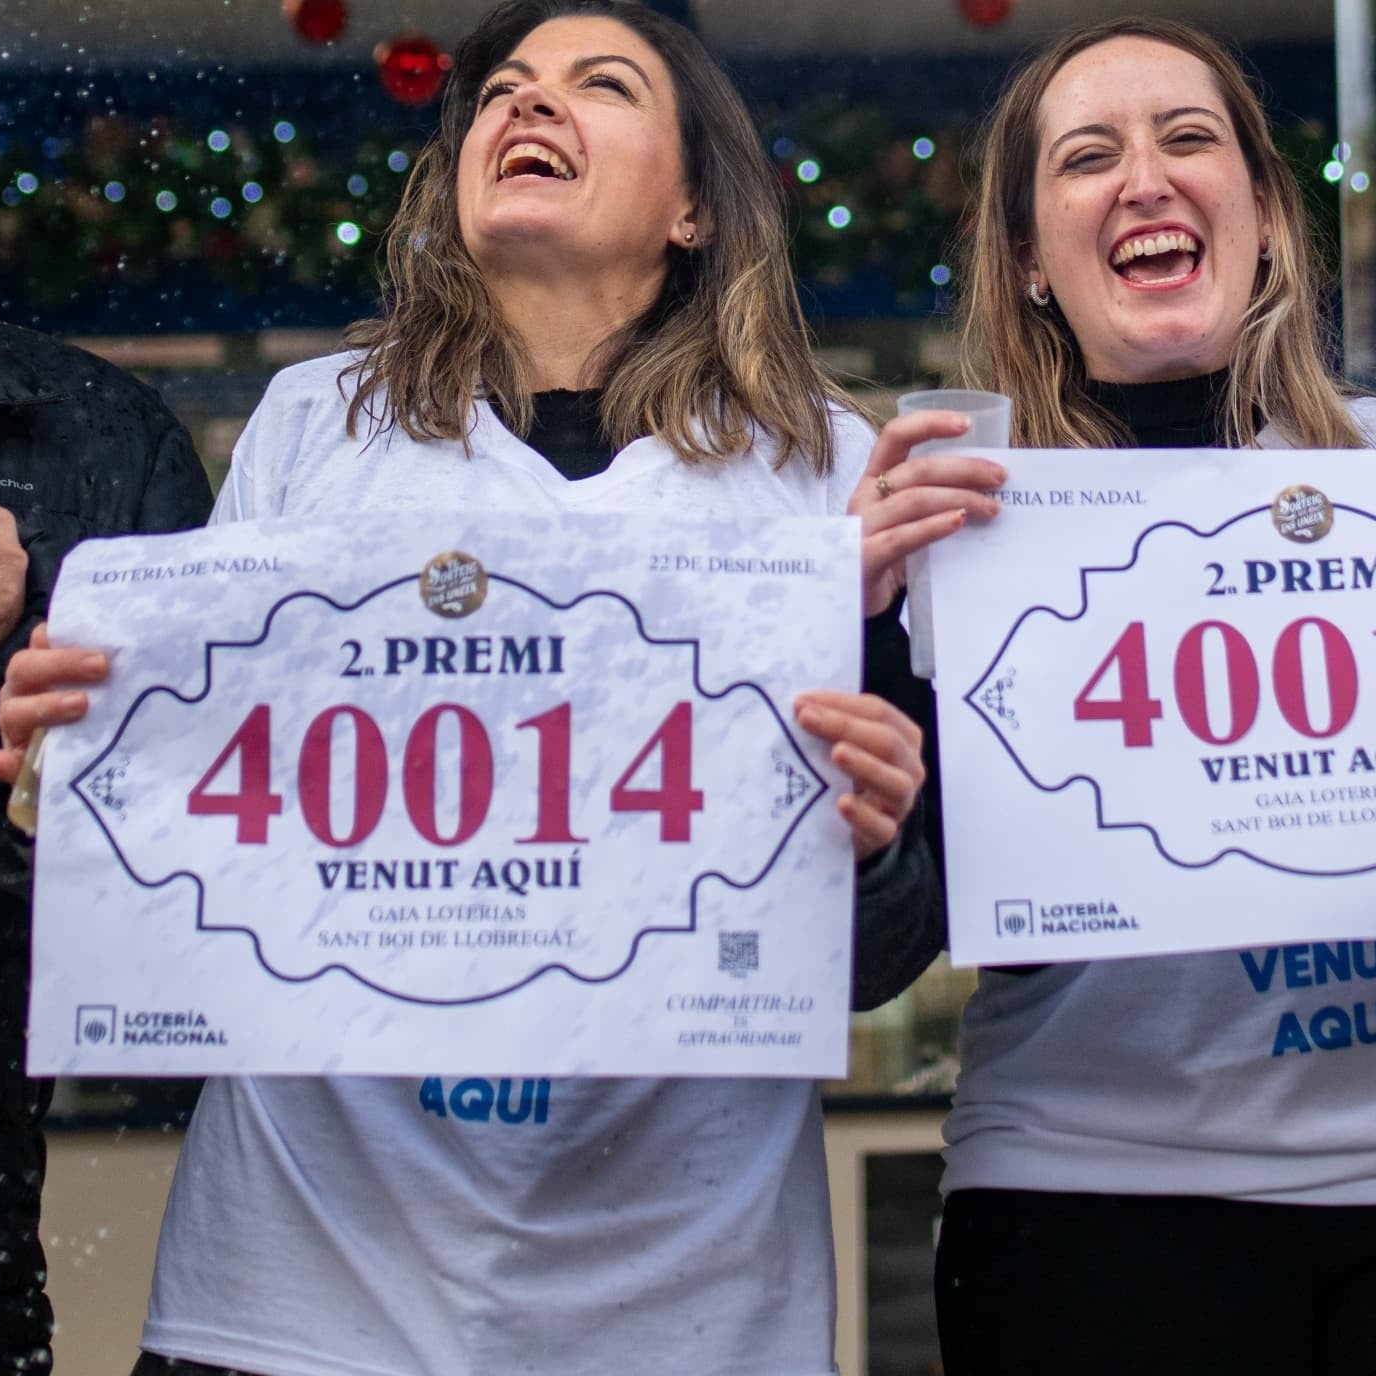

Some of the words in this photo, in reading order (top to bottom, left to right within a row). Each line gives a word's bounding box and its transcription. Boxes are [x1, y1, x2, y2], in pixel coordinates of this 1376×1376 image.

[982, 489, 1044, 506] TERIA
[1049, 489, 1074, 505] DE
[1080, 489, 1147, 505] NADAL
[92, 565, 175, 585] LOTERIA
[181, 561, 208, 576] DE
[212, 556, 284, 575] NADAL
[647, 554, 670, 572] 22
[675, 555, 703, 572] DE
[708, 555, 817, 575] DESEMBRE
[383, 635, 565, 676] PREMI
[186, 700, 705, 849] 40014
[1200, 748, 1336, 784] VENUT
[1255, 791, 1305, 809] GAIA
[1210, 816, 1262, 835] SANT
[1268, 814, 1303, 830] BOI
[1307, 811, 1334, 826] DE
[316, 858, 461, 890] VENUT
[470, 848, 584, 895] AQUÍ
[368, 903, 420, 923] GAIA
[427, 903, 527, 922] LOTERIAS
[1040, 899, 1119, 919] LOTERÍA
[1040, 916, 1141, 935] NACIONAL
[317, 929, 373, 949] SANT
[378, 930, 416, 949] BOI
[420, 930, 448, 948] DE
[453, 929, 577, 948] LLOBREGAT
[666, 994, 814, 1012] COMPARTIR-LO
[124, 1008, 209, 1027] LOTERÍA
[123, 1029, 229, 1046] NACIONAL
